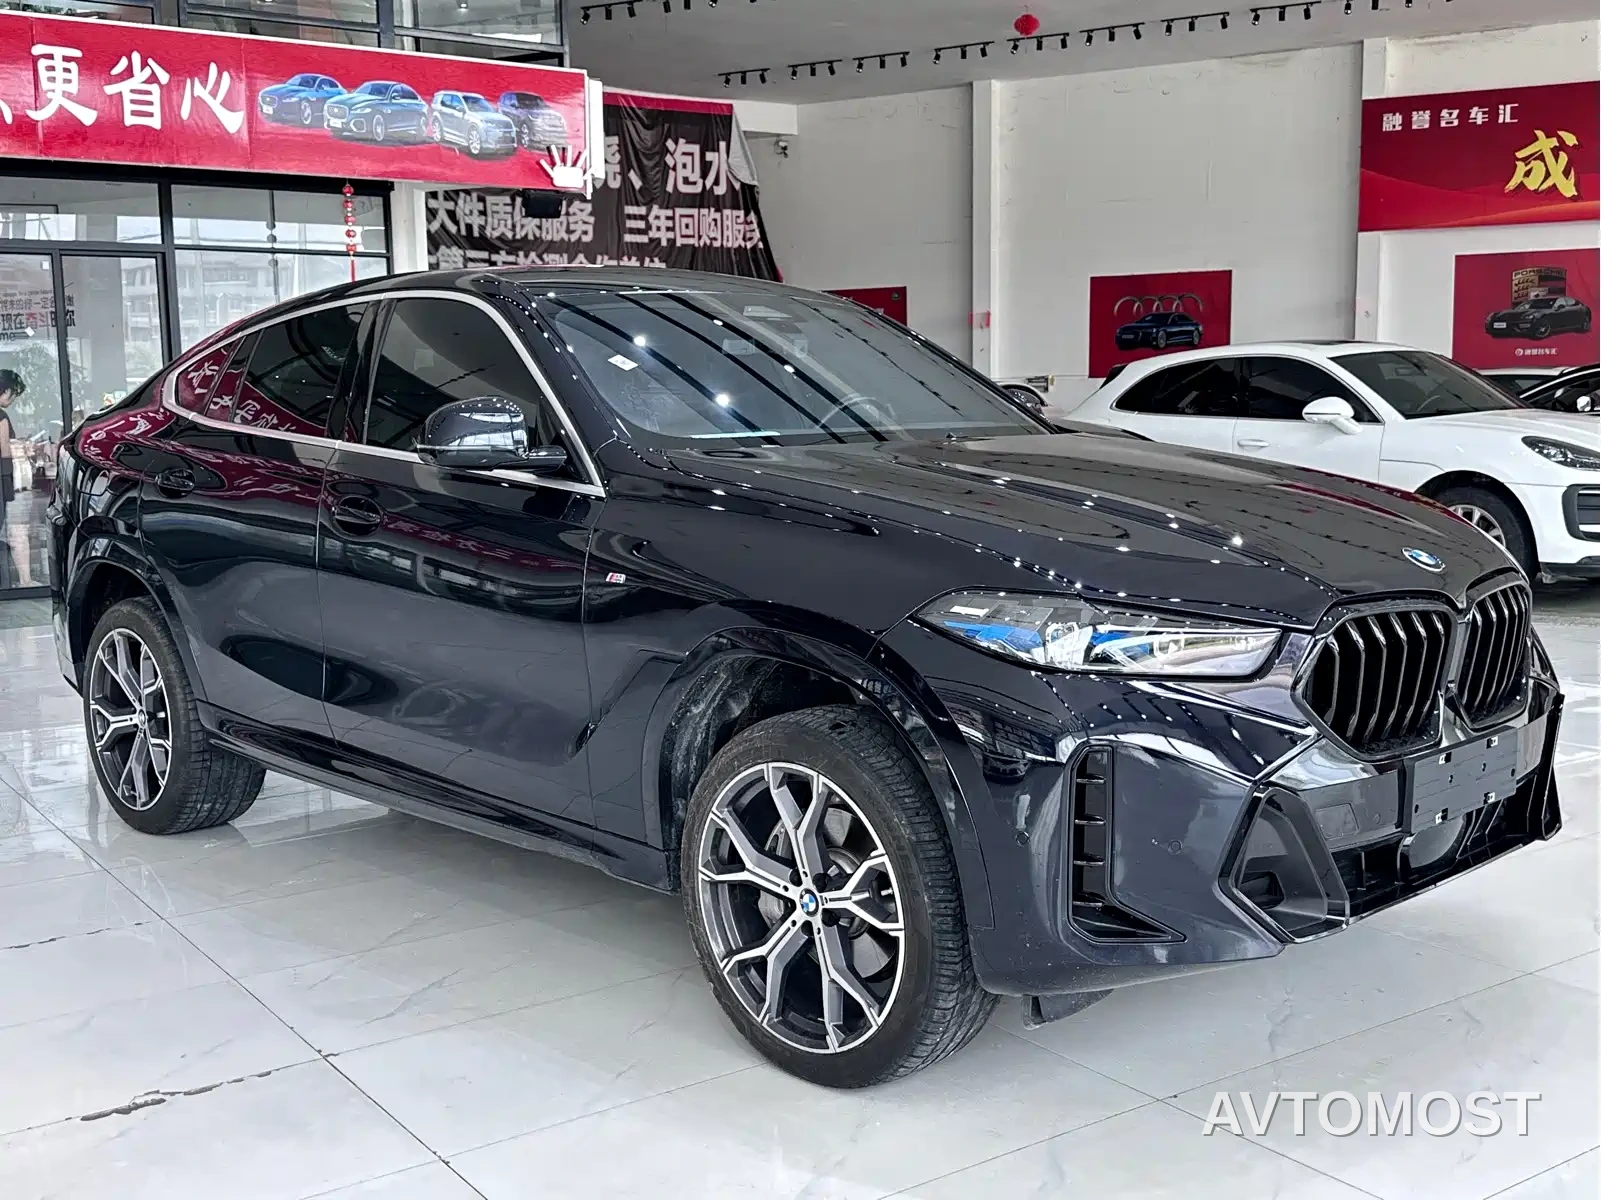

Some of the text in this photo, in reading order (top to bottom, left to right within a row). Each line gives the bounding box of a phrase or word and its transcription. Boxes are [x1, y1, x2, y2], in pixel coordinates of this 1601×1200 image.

[0, 44, 244, 134] 更省心
[1382, 104, 1519, 132] 融誉名车汇
[1504, 129, 1579, 198] 成
